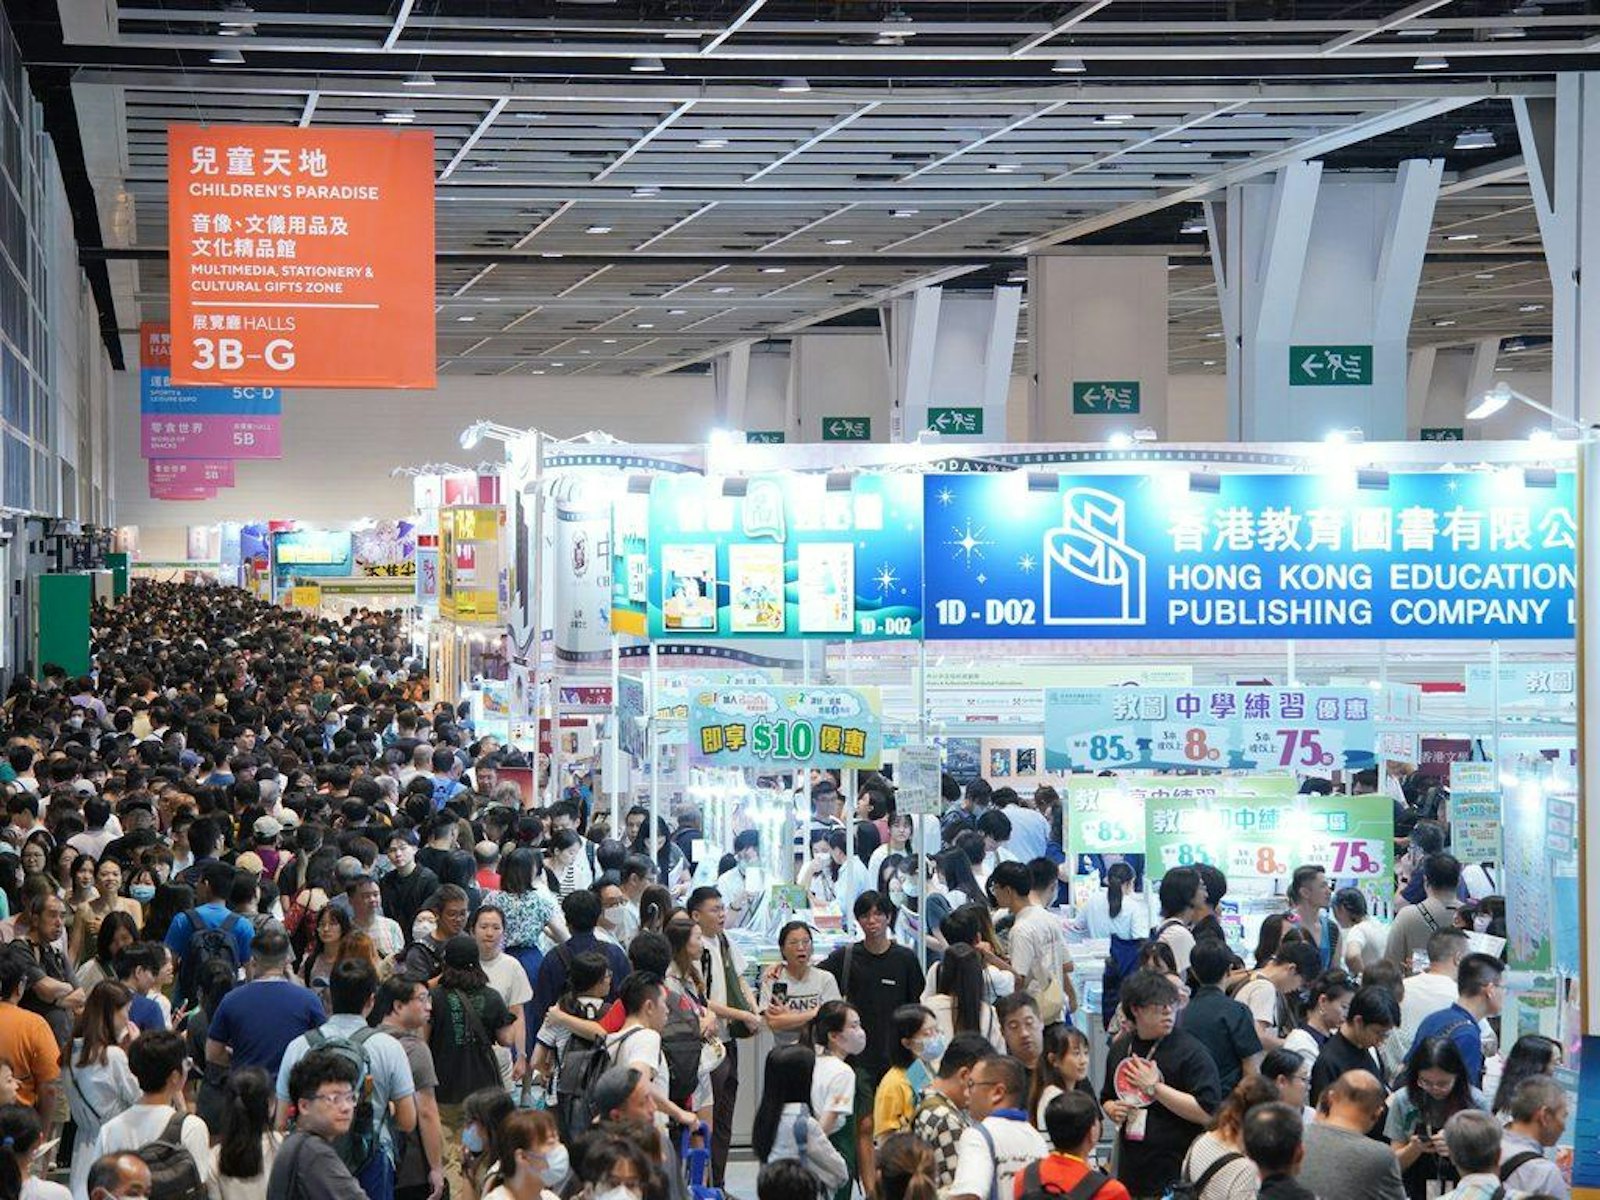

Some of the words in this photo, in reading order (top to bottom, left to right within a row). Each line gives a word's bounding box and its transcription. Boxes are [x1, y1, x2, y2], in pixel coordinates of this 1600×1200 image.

[189, 145, 328, 177] 兒童天地
[189, 183, 292, 198] CHILDREN'S
[296, 185, 379, 200] PARADISE
[191, 213, 349, 236] 音像、文儀用品及
[191, 238, 296, 258] 文化精品館
[191, 264, 279, 277] MULTIMEDIA,
[281, 266, 362, 278] STATIONERY
[365, 267, 374, 278] &
[191, 280, 261, 292] CULTURAL
[264, 281, 303, 292] GIFTS
[305, 282, 344, 293] ZONE
[244, 316, 296, 331] HALLS
[191, 337, 296, 371] 3B-G
[151, 422, 203, 434] 零食世界
[233, 432, 255, 445] 5B
[1167, 506, 1577, 551] 香港教育圖書有限公
[1168, 564, 1262, 590] HONG
[1280, 564, 1373, 590] KONG
[1390, 564, 1577, 590] EDUCATION
[1168, 599, 1373, 625] PUBLISHING
[1390, 599, 1549, 625] COMPANY
[753, 716, 814, 760] $10
[786, 998, 819, 1011] ANS
